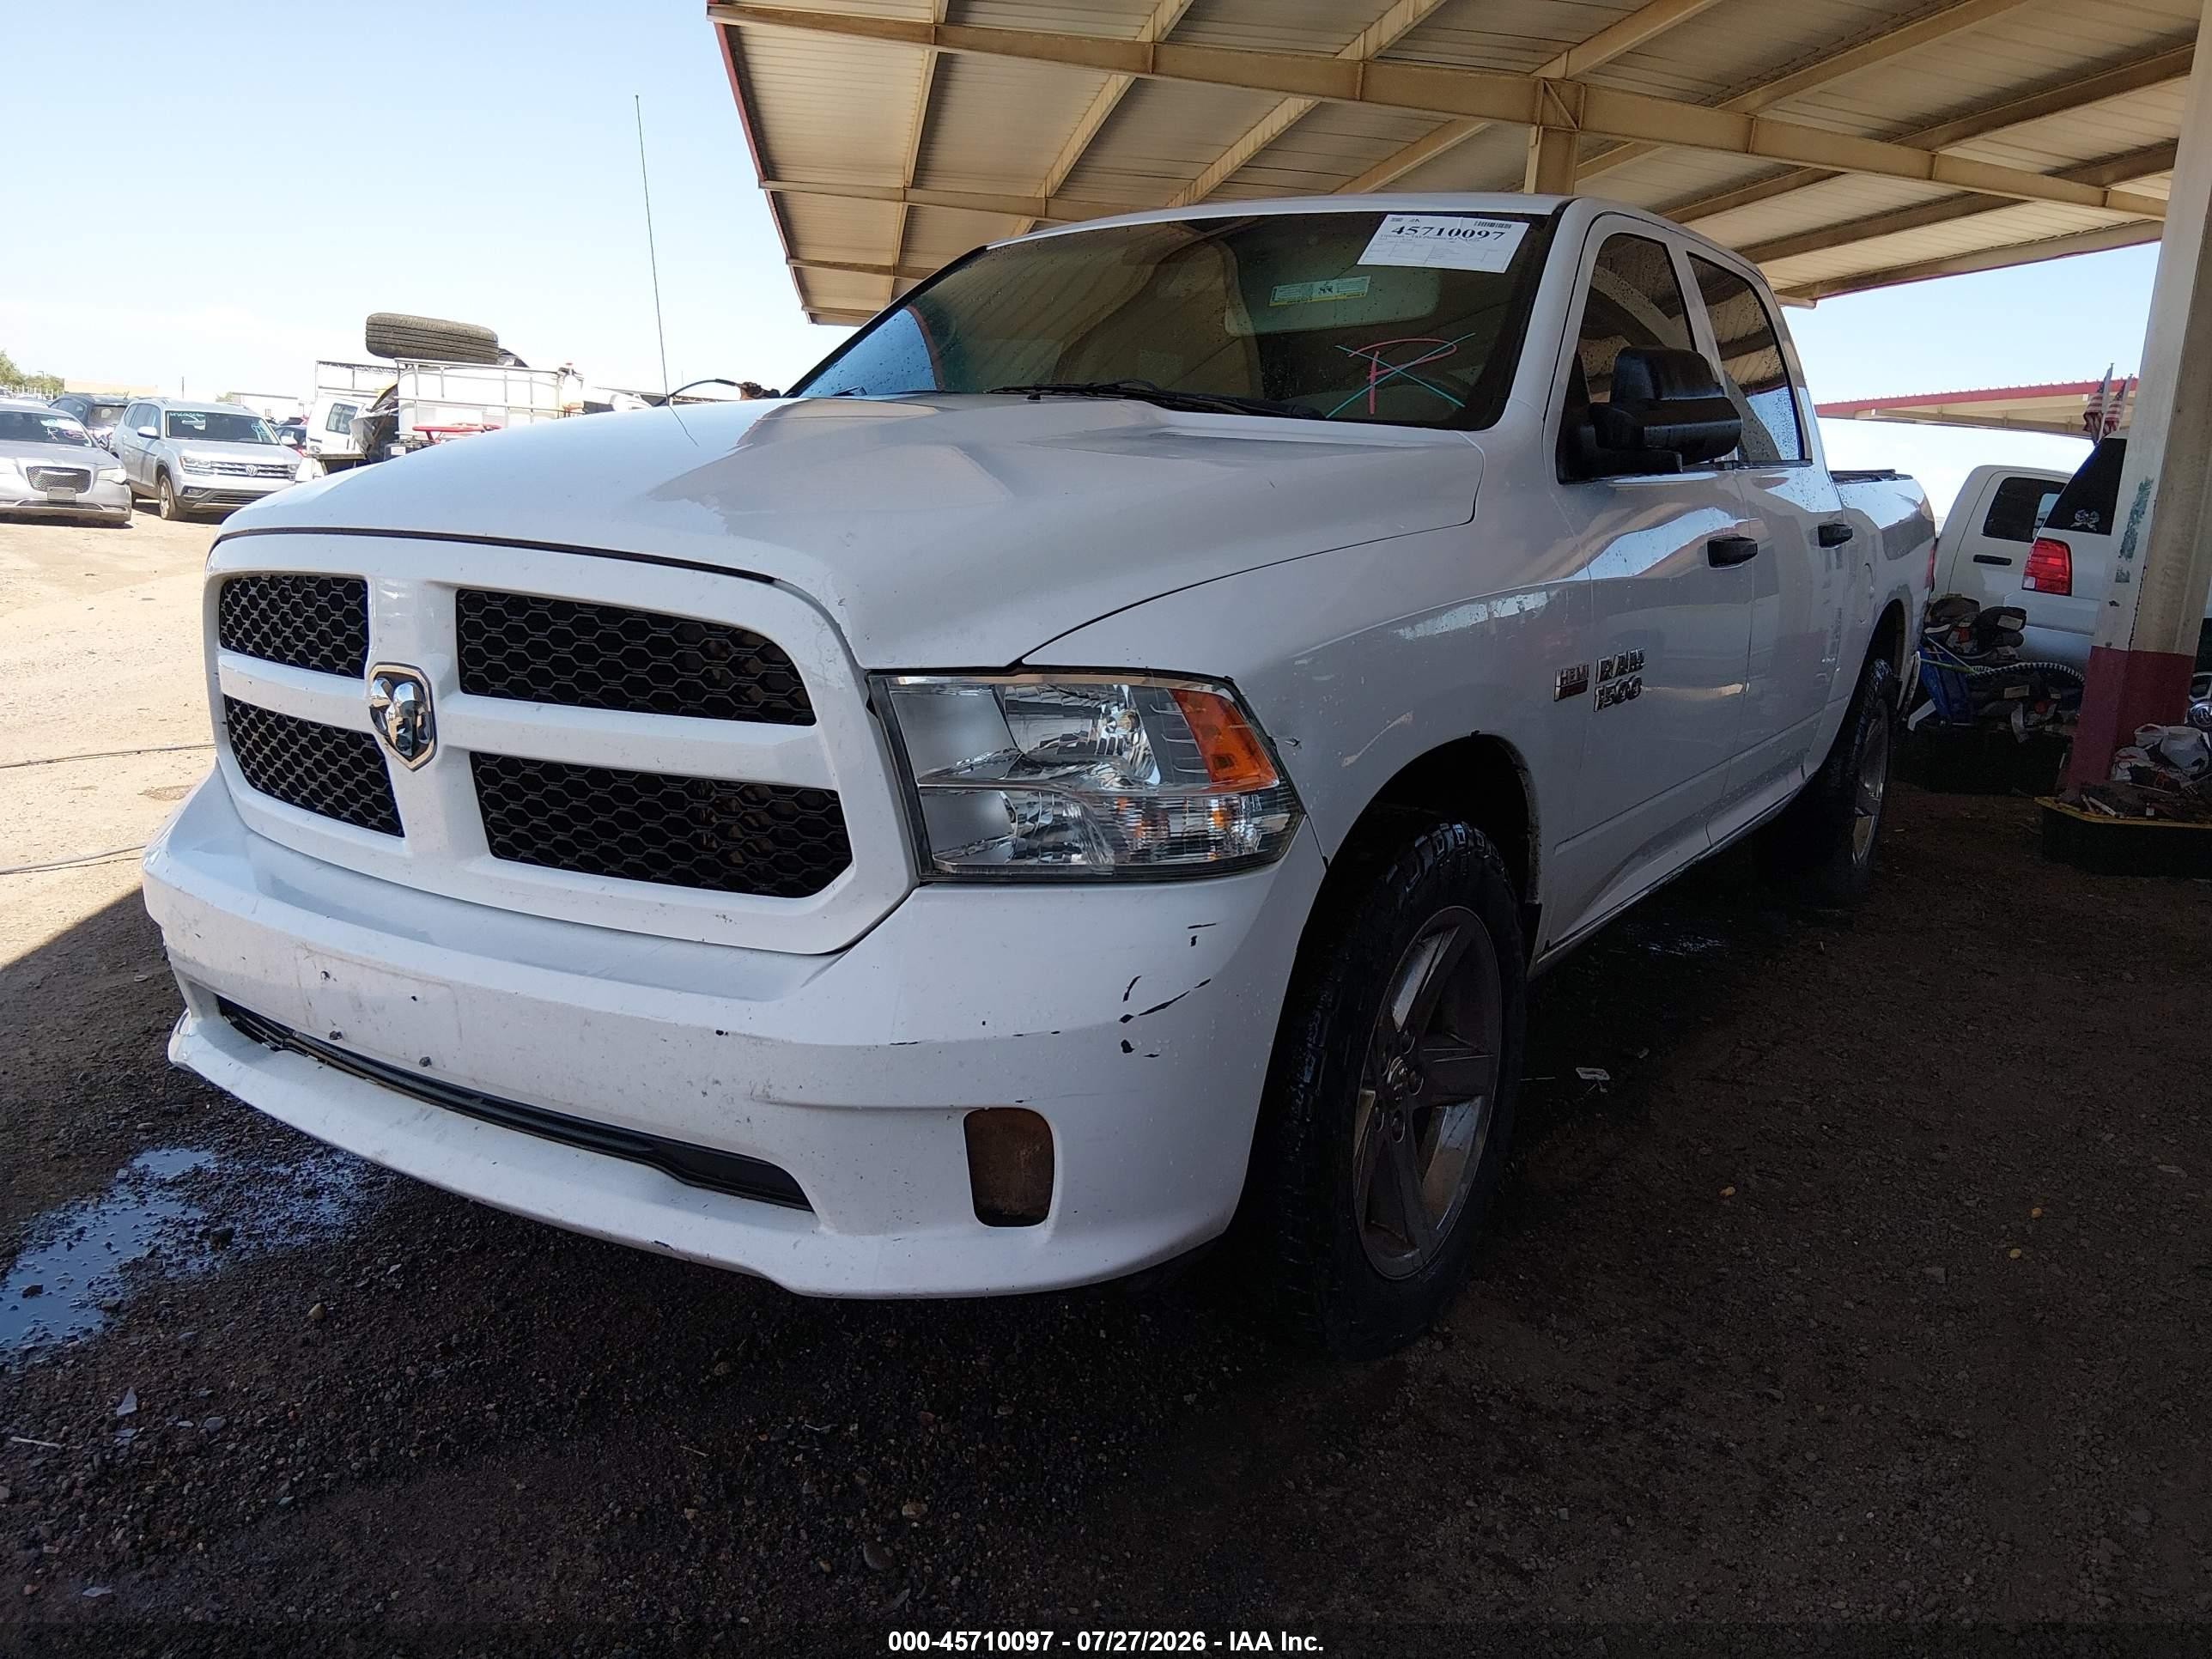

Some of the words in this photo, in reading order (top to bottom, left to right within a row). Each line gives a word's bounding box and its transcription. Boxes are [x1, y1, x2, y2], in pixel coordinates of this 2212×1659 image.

[1391, 225, 1505, 240] 45710097
[1595, 648, 1645, 683] RAM
[1594, 675, 1643, 712] 1500
